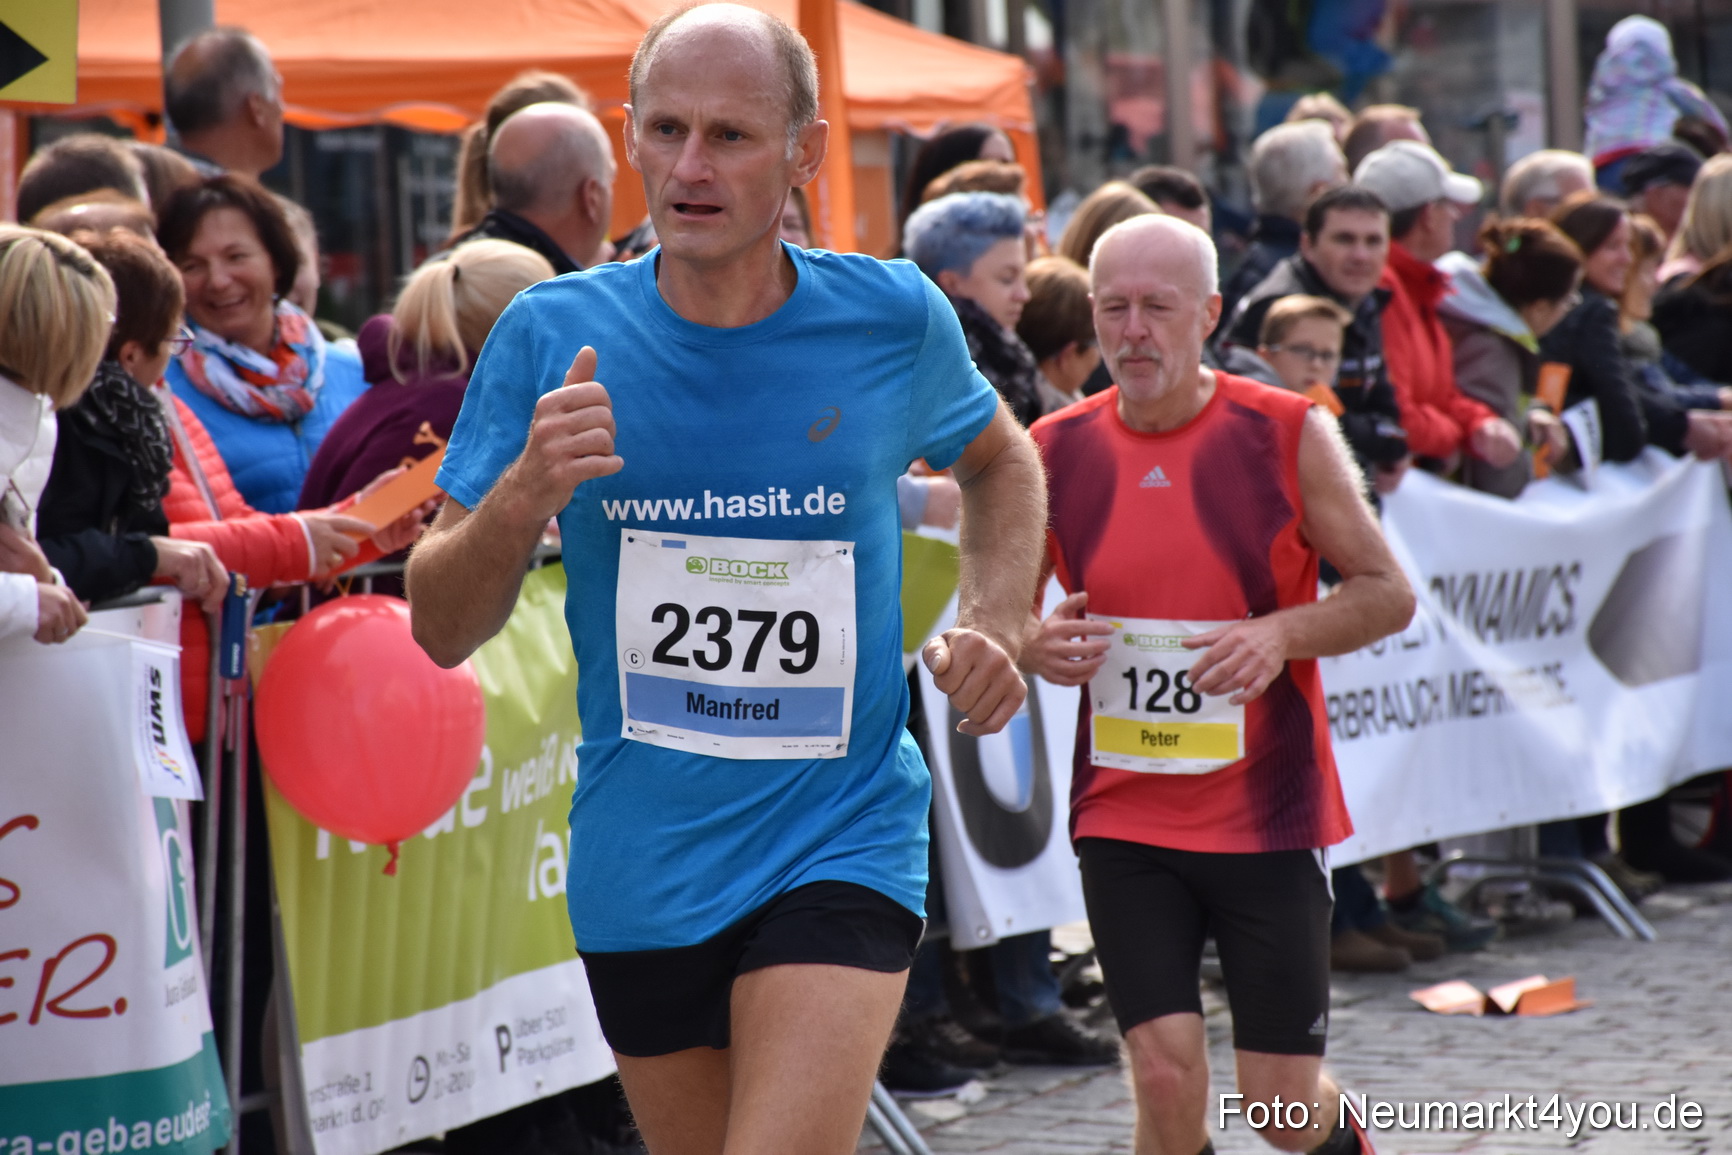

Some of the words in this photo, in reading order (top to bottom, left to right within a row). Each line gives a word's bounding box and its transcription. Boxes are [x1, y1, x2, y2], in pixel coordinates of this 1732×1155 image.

[602, 486, 846, 521] www.hasit.de
[709, 557, 789, 580] BOCK
[709, 576, 733, 584] inspired
[651, 602, 820, 674] 2379
[630, 652, 639, 665] C
[1122, 666, 1203, 714] 128
[686, 692, 780, 720] Manfred
[1141, 729, 1181, 747] Peter
[528, 818, 571, 902] la
